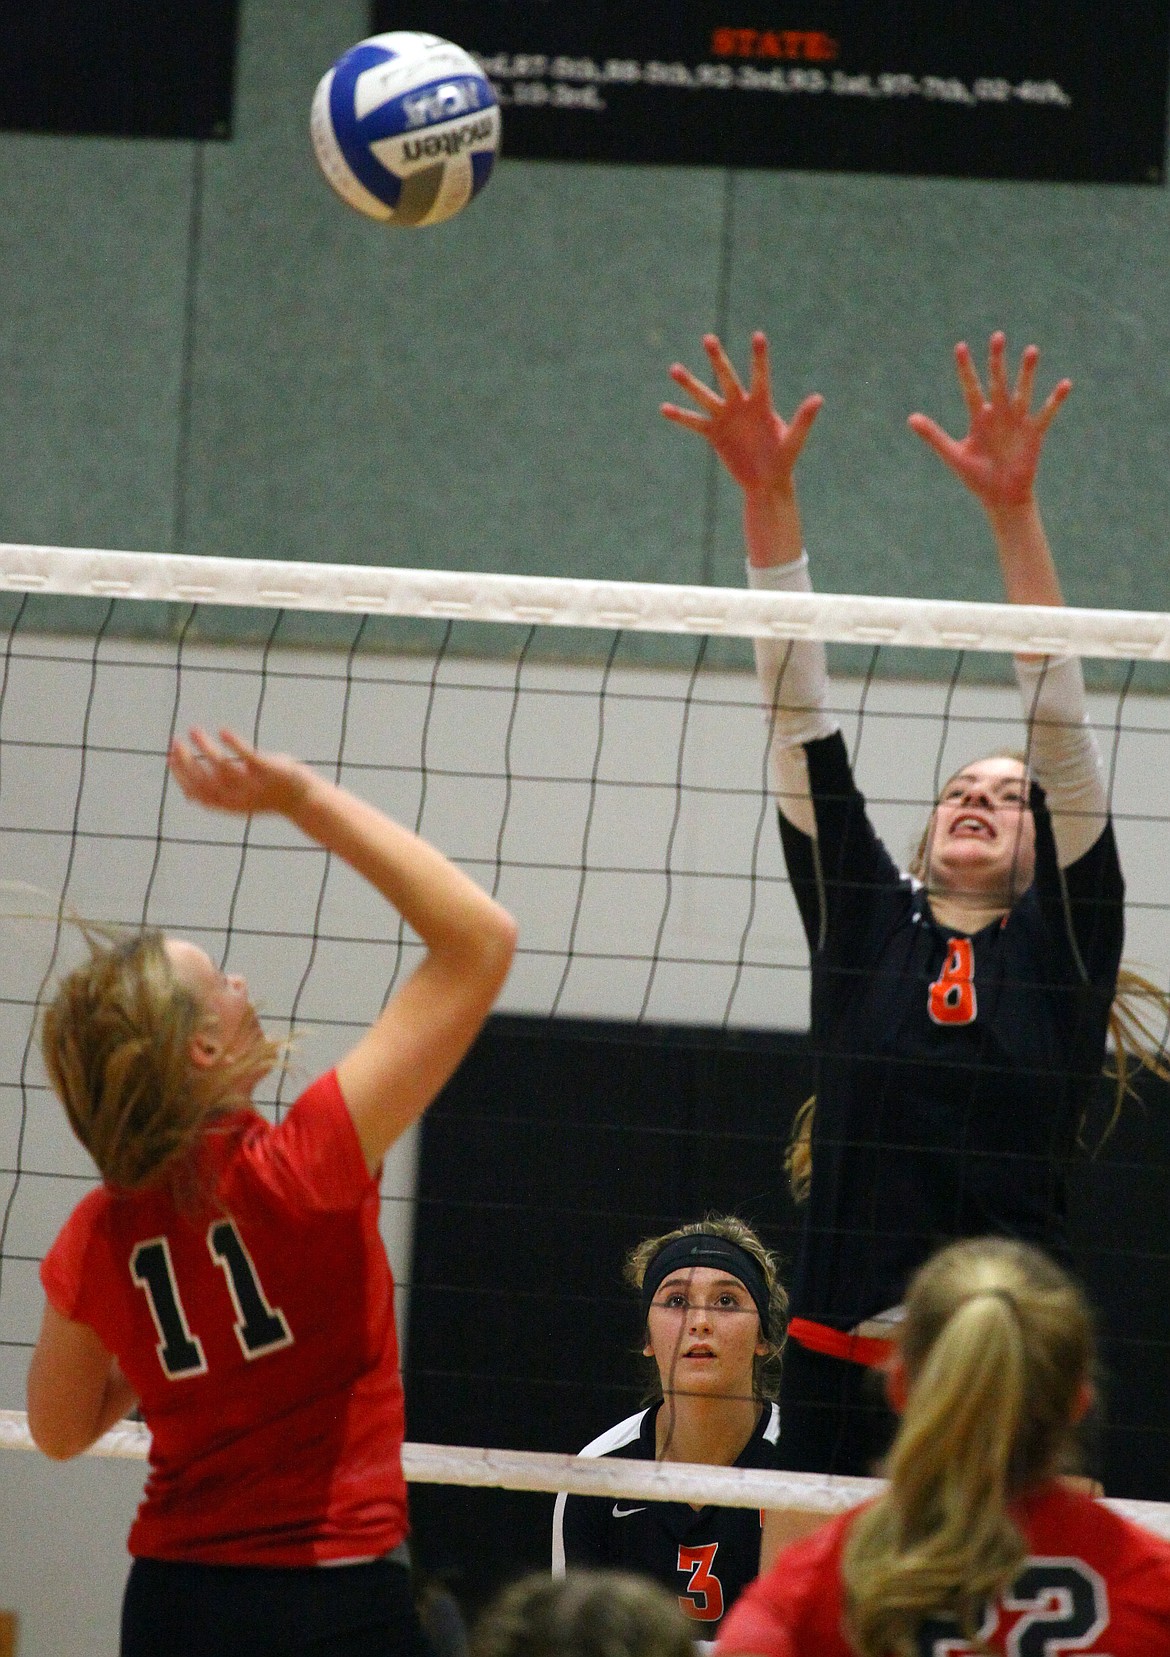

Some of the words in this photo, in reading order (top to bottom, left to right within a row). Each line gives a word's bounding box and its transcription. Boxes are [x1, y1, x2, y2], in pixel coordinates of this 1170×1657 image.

[711, 27, 838, 61] STATE:
[927, 937, 978, 1026] 8
[128, 1217, 295, 1382] 11
[677, 1542, 725, 1622] 3
